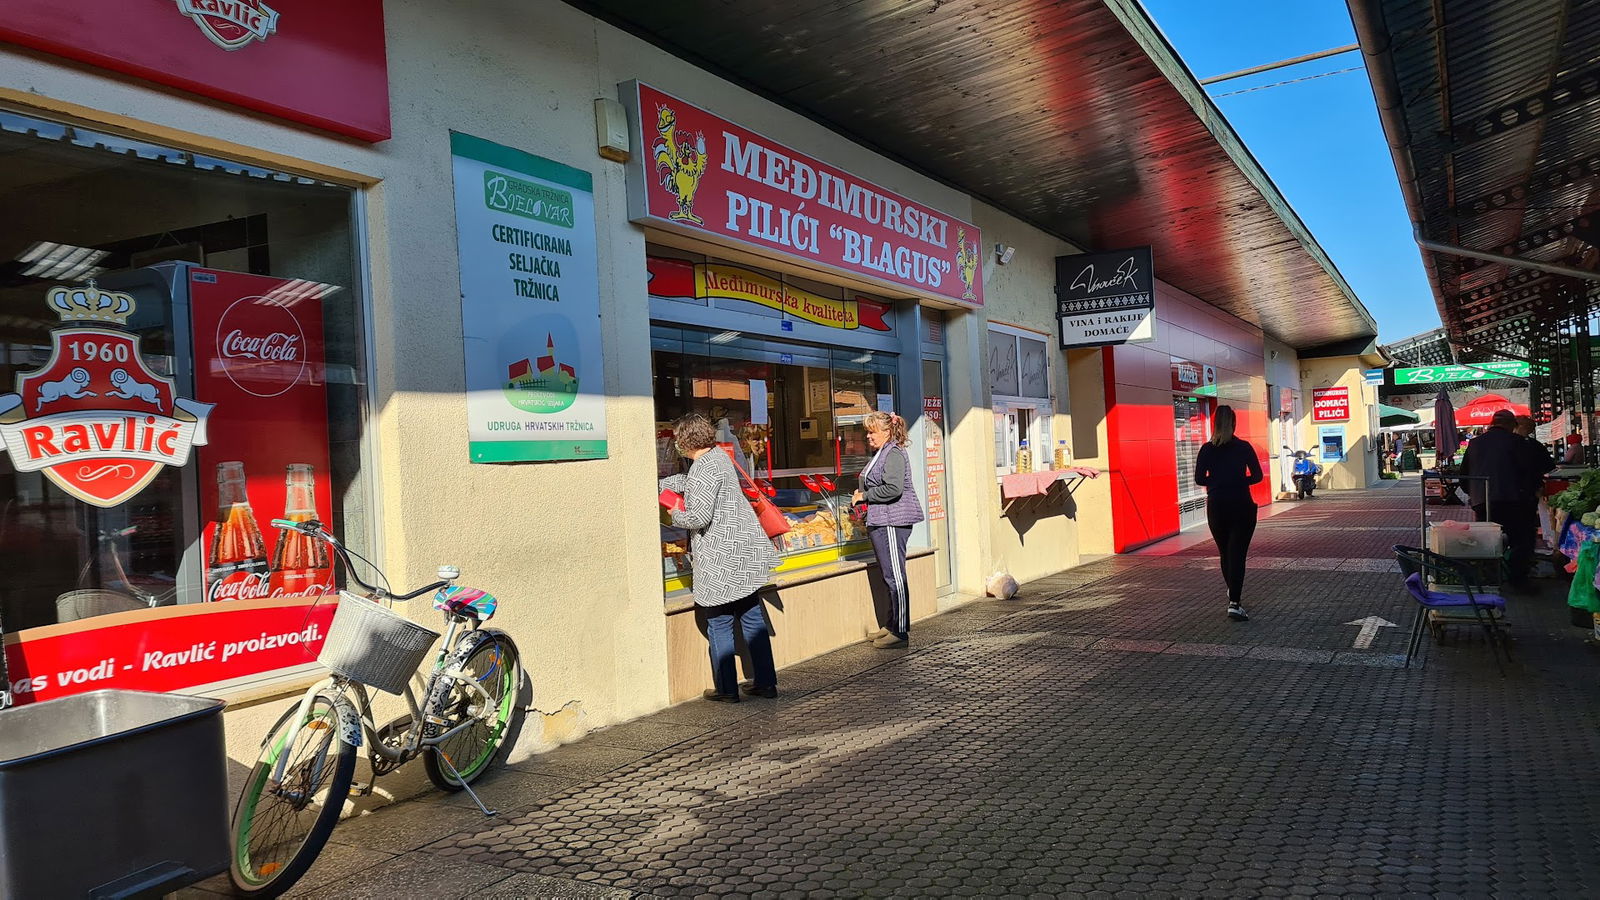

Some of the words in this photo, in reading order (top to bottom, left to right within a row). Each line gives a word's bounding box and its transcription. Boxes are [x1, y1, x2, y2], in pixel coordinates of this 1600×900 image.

[507, 180, 540, 197] GRADSKA
[721, 131, 948, 248] MEĐIMURSKI
[726, 190, 819, 254] PILIĆI
[492, 224, 572, 256] CERTIFICIRANA
[509, 253, 561, 278] SELJAČKA
[514, 278, 559, 302] TRŽNICA
[802, 298, 854, 322] kvaliteta
[1069, 318, 1094, 327] VINA
[1105, 313, 1143, 324] RAKIJE
[1084, 325, 1129, 337] DOMAĆE
[69, 341, 129, 363] 1960
[222, 329, 300, 360] Coca-Cola
[1315, 397, 1347, 408] DOMAĆI
[1319, 408, 1344, 418] PILIĆI
[487, 421, 521, 431] UDRUGA
[525, 421, 564, 431] HRVATSKIH
[566, 419, 594, 431] TRŽNICA
[22, 416, 181, 459] Ravlić
[208, 571, 271, 602] Coca-Cola
[57, 658, 115, 687] vodi
[142, 640, 216, 672] Ravlić
[222, 624, 322, 662] proizvodi.
